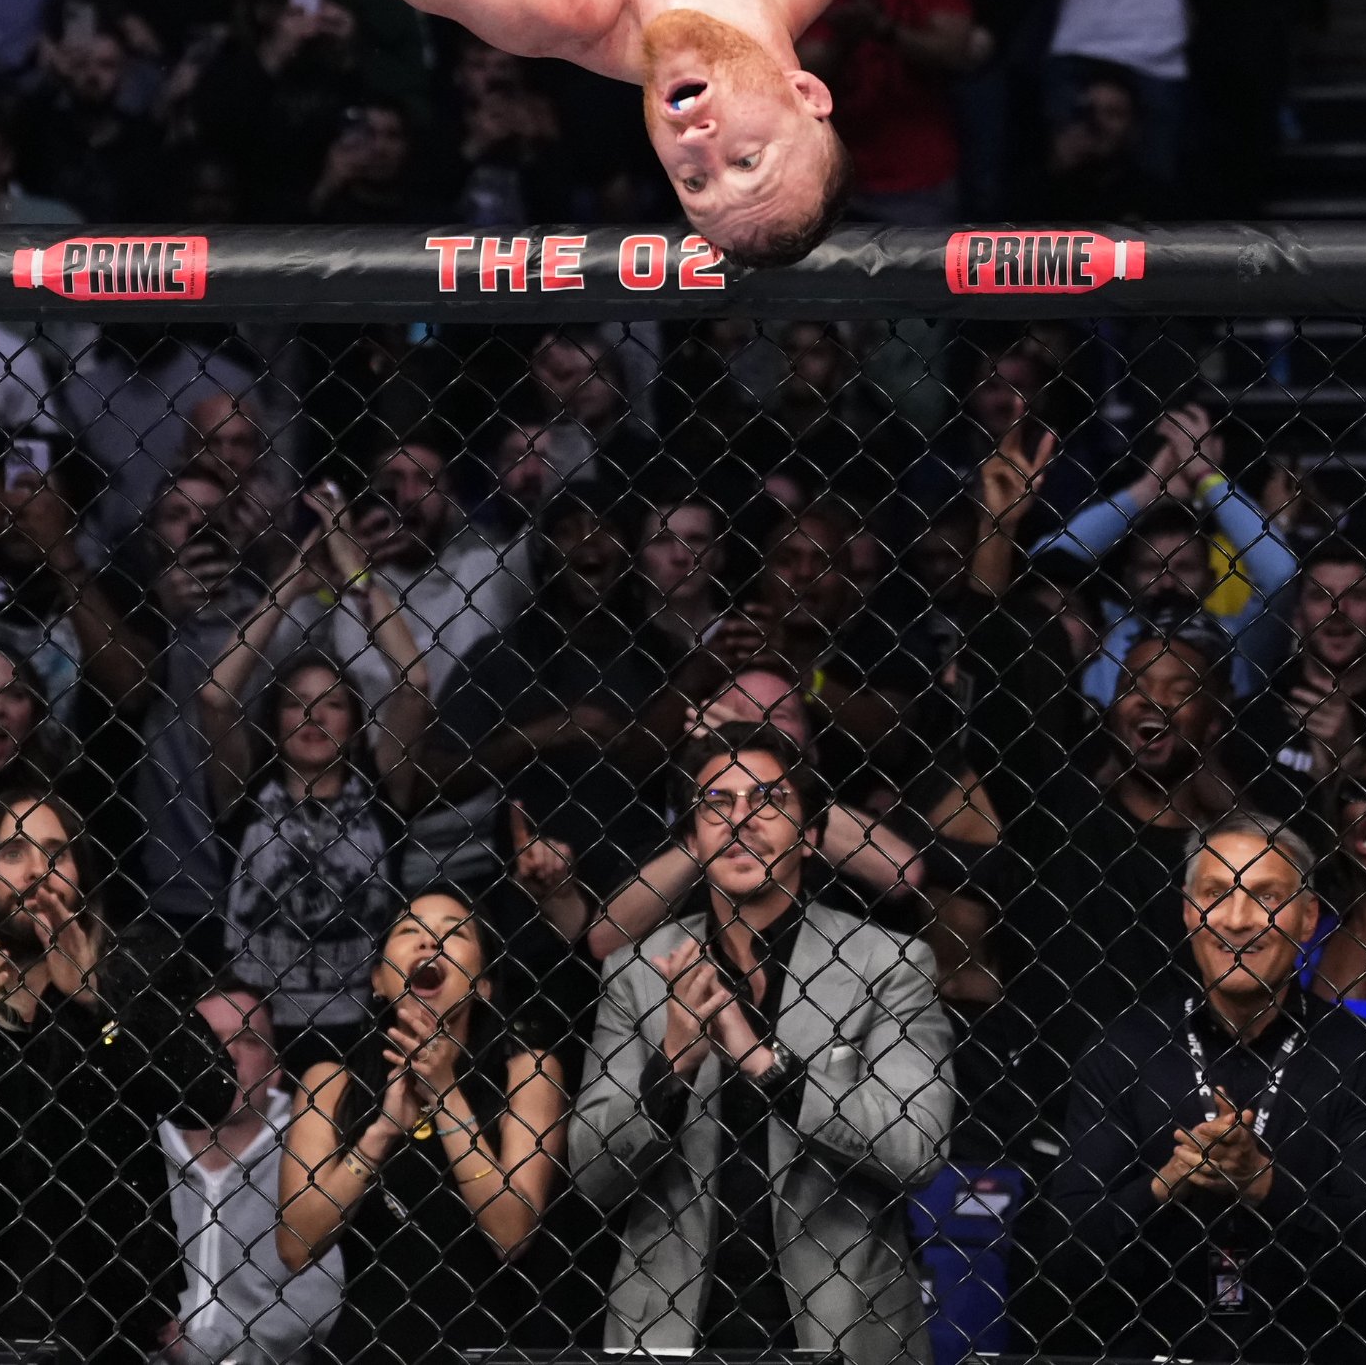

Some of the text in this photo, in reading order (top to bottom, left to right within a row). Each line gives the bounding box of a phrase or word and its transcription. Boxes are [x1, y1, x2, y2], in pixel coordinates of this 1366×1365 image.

[62, 242, 188, 295] PRIME
[425, 235, 587, 292] THE
[967, 235, 1096, 287] PRIME
[1253, 1107, 1270, 1136] UFC
